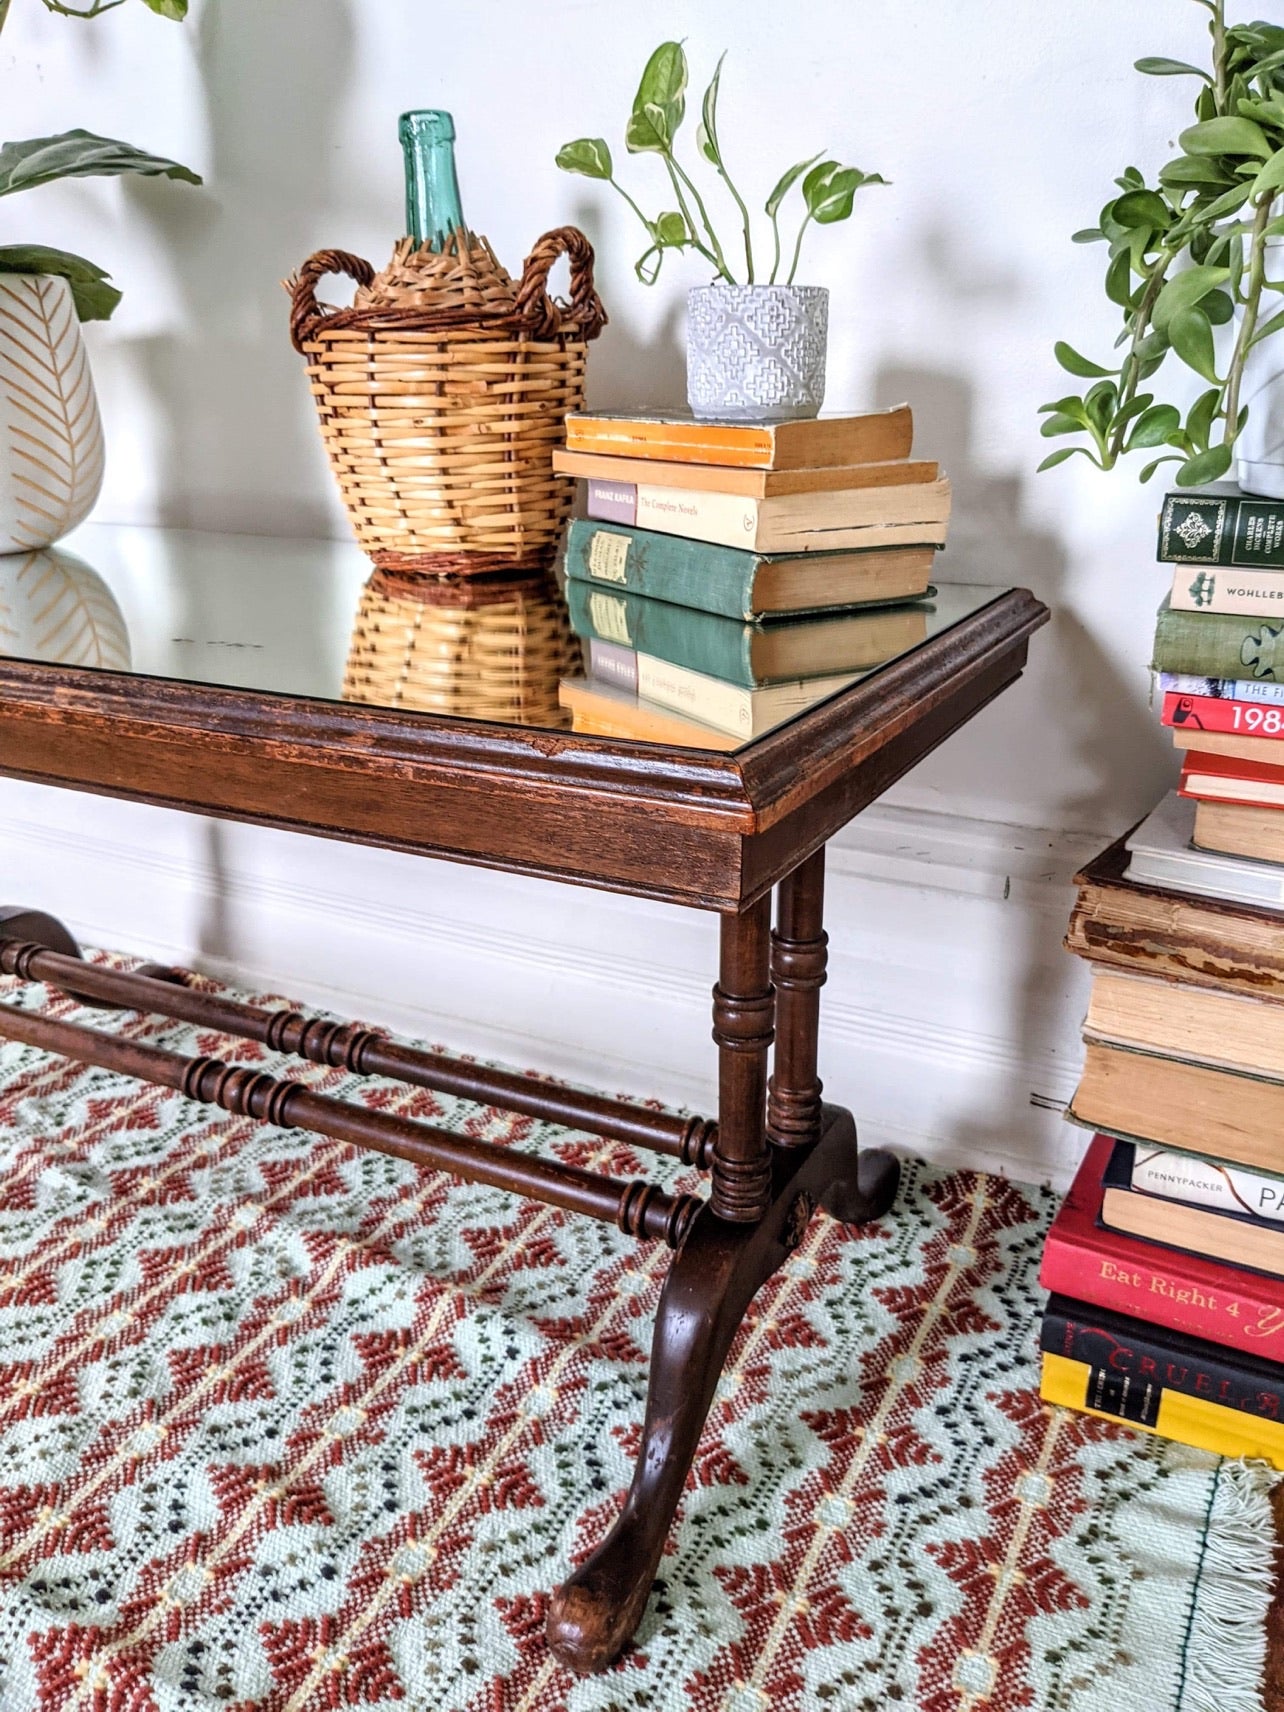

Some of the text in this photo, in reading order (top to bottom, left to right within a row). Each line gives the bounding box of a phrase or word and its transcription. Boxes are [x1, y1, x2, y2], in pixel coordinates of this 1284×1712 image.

[594, 489, 634, 505] FRANZ KAFKA
[641, 497, 698, 516] The Complete Novels
[1245, 516, 1256, 551] CHARLES
[1253, 517, 1264, 551] DICKENS
[1264, 514, 1277, 554] COMPLETE
[1273, 520, 1284, 548] WORKS
[1227, 588, 1284, 600] WOHLLEB
[1245, 684, 1268, 696] THE
[1232, 706, 1284, 734] 198
[1148, 1170, 1223, 1192] PENNYPACKER
[1100, 1261, 1141, 1288] Eat
[1149, 1276, 1217, 1310] Right
[1225, 1302, 1240, 1318] 4
